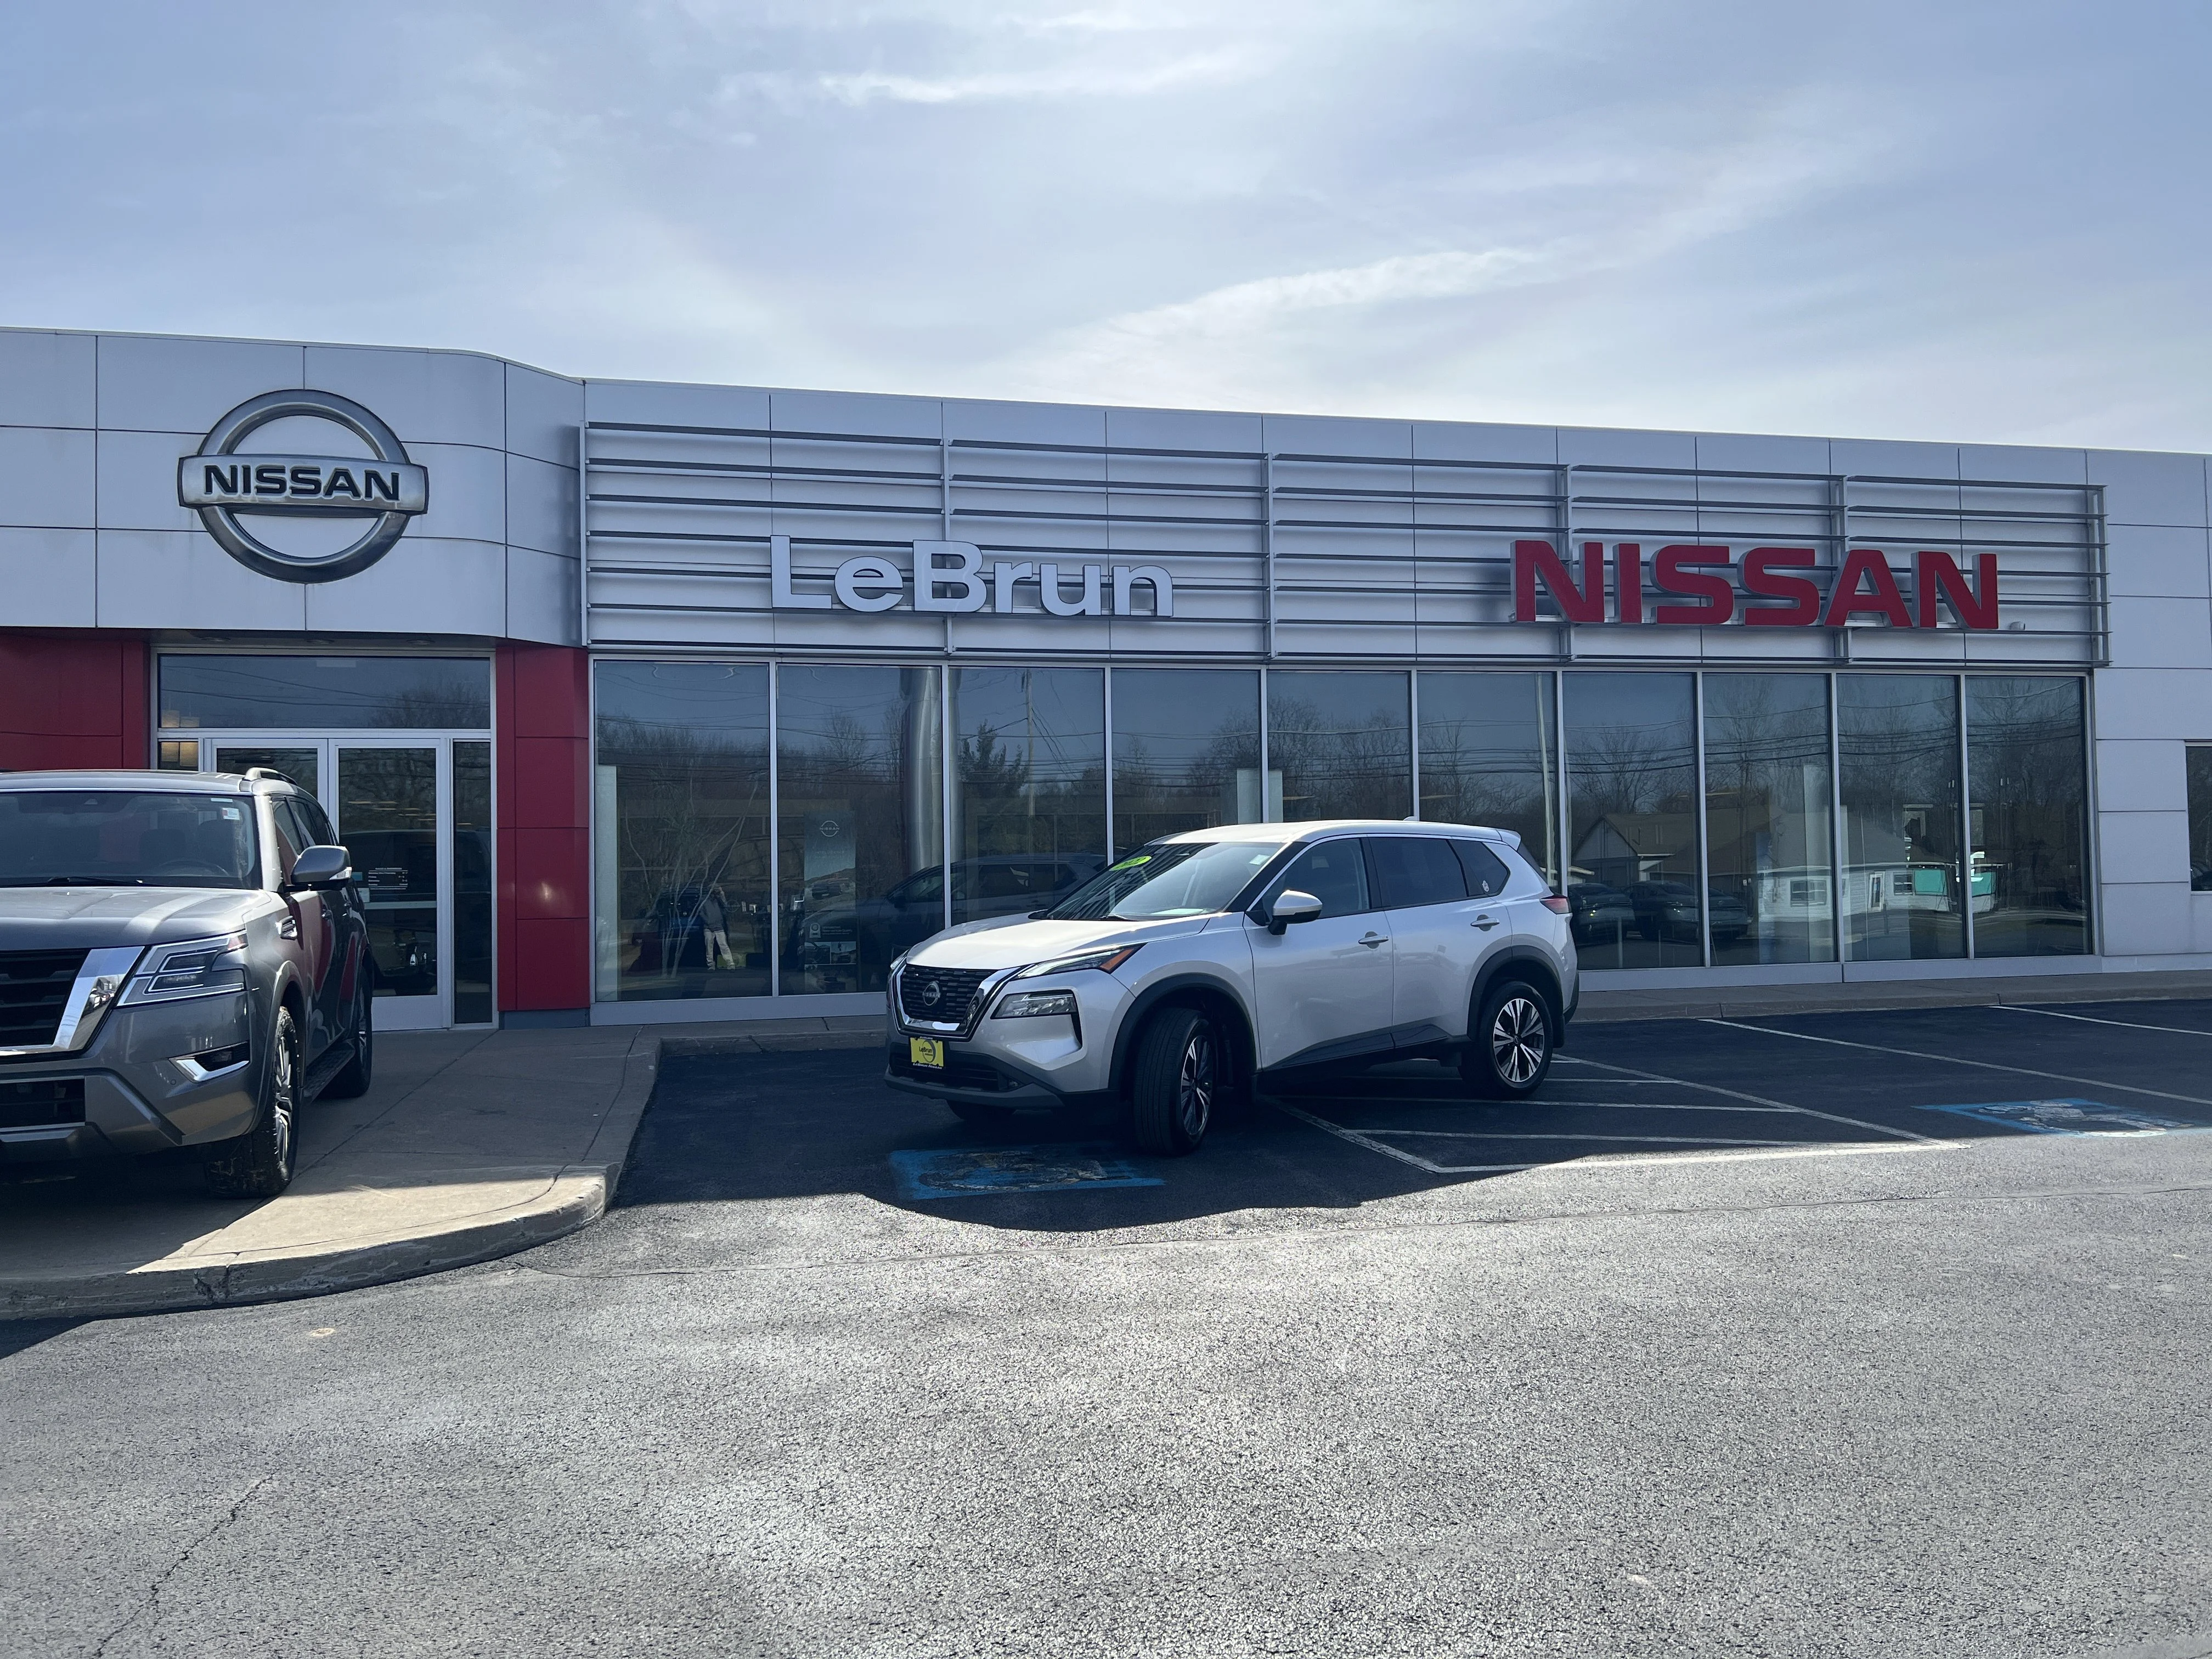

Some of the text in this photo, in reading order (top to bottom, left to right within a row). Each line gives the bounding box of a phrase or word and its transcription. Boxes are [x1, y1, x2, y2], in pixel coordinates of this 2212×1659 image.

[204, 464, 400, 501] NISSAN
[770, 535, 1174, 618] LeBrun
[1510, 540, 1999, 630] NISSAN
